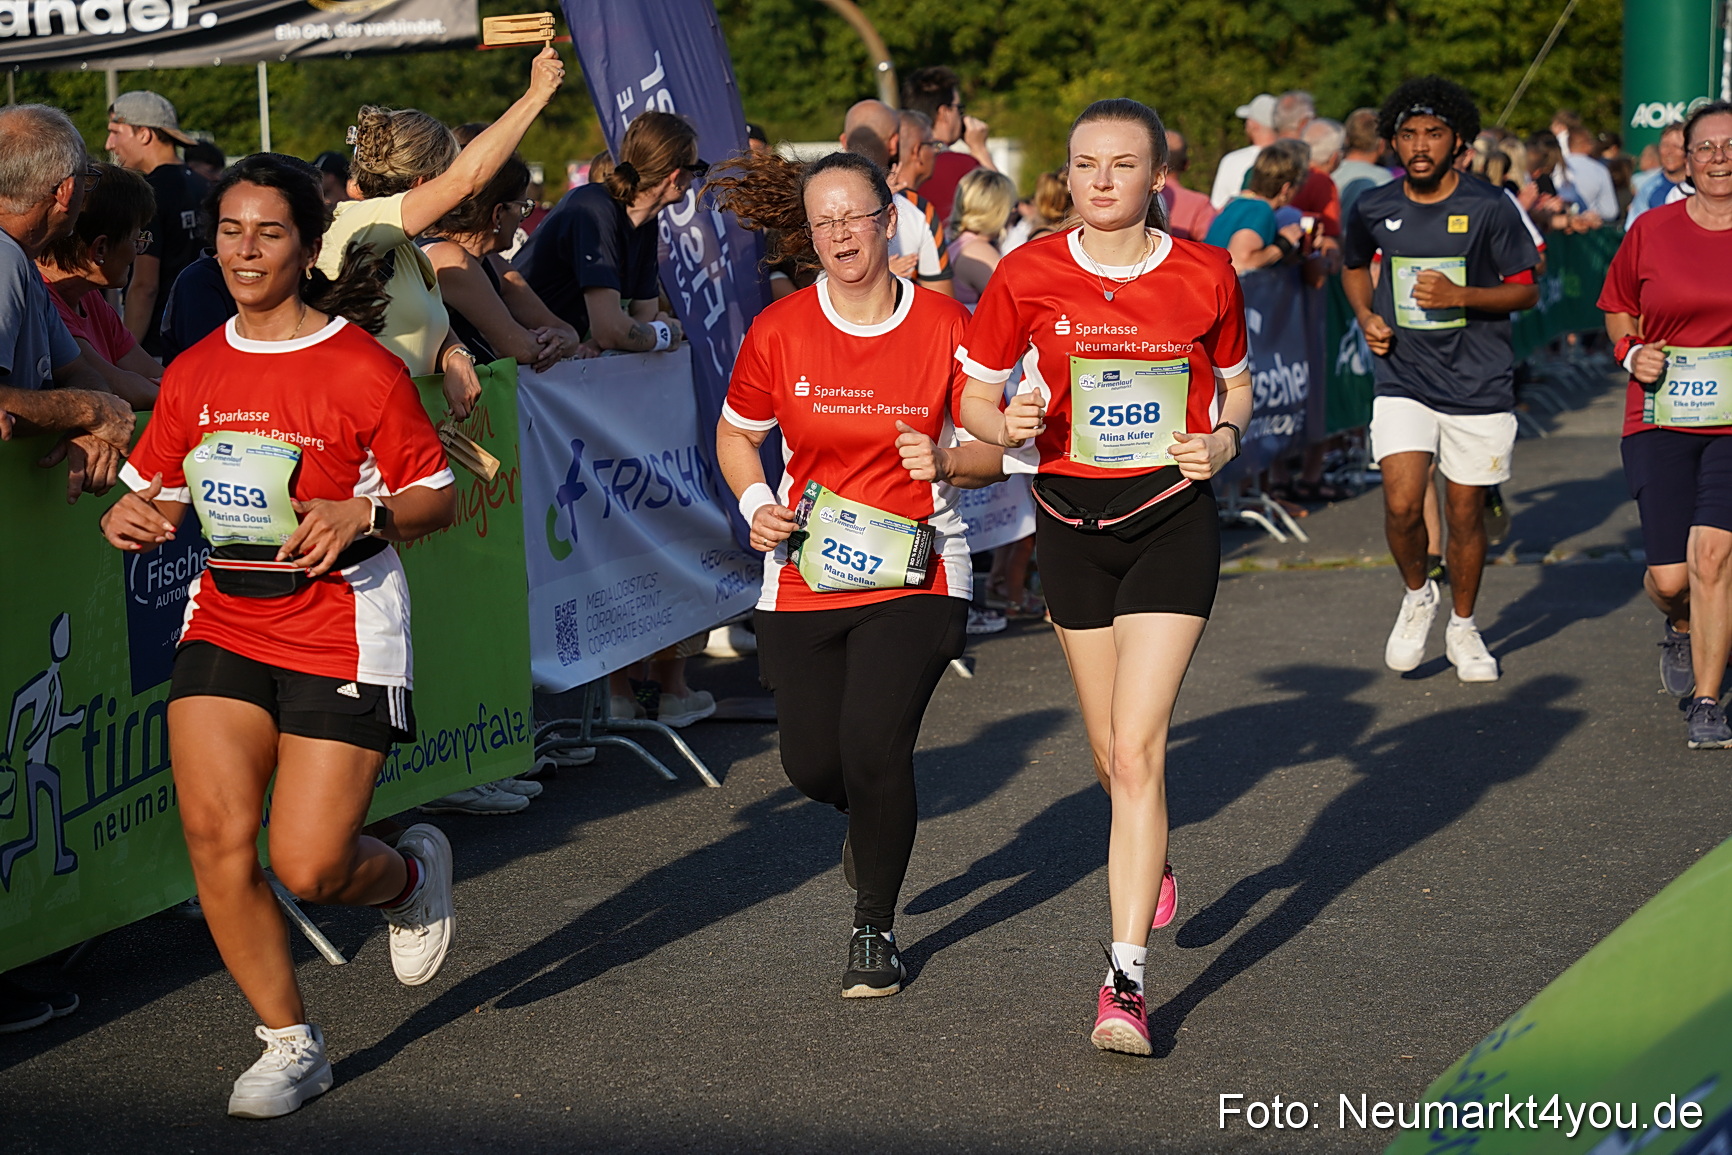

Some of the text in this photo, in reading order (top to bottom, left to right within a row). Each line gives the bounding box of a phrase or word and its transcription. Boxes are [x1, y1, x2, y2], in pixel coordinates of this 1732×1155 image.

[1630, 101, 1686, 128] AOK
[1075, 323, 1138, 337] Sparkasse
[1075, 341, 1194, 353] Neumarkt-Parsberg
[814, 385, 874, 398] Sparkasse
[1097, 379, 1133, 388] Firmenlauf
[1668, 380, 1718, 396] 2782
[213, 409, 270, 425] Sparkasse
[812, 402, 929, 418] Neumarkt-Parsberg
[1089, 402, 1160, 427] 2568
[1099, 430, 1154, 442] Alina Kufer
[202, 480, 268, 509] 2553
[208, 509, 272, 523] Marina Gousi
[909, 557, 915, 566] 20
[912, 528, 923, 553] RABATT
[821, 537, 884, 575] 2537
[824, 563, 845, 579] Mara
[847, 572, 876, 586] Bellan
[586, 590, 662, 633] CORPORATE PRINT
[588, 607, 673, 655] CORPORATE SIGNAGE
